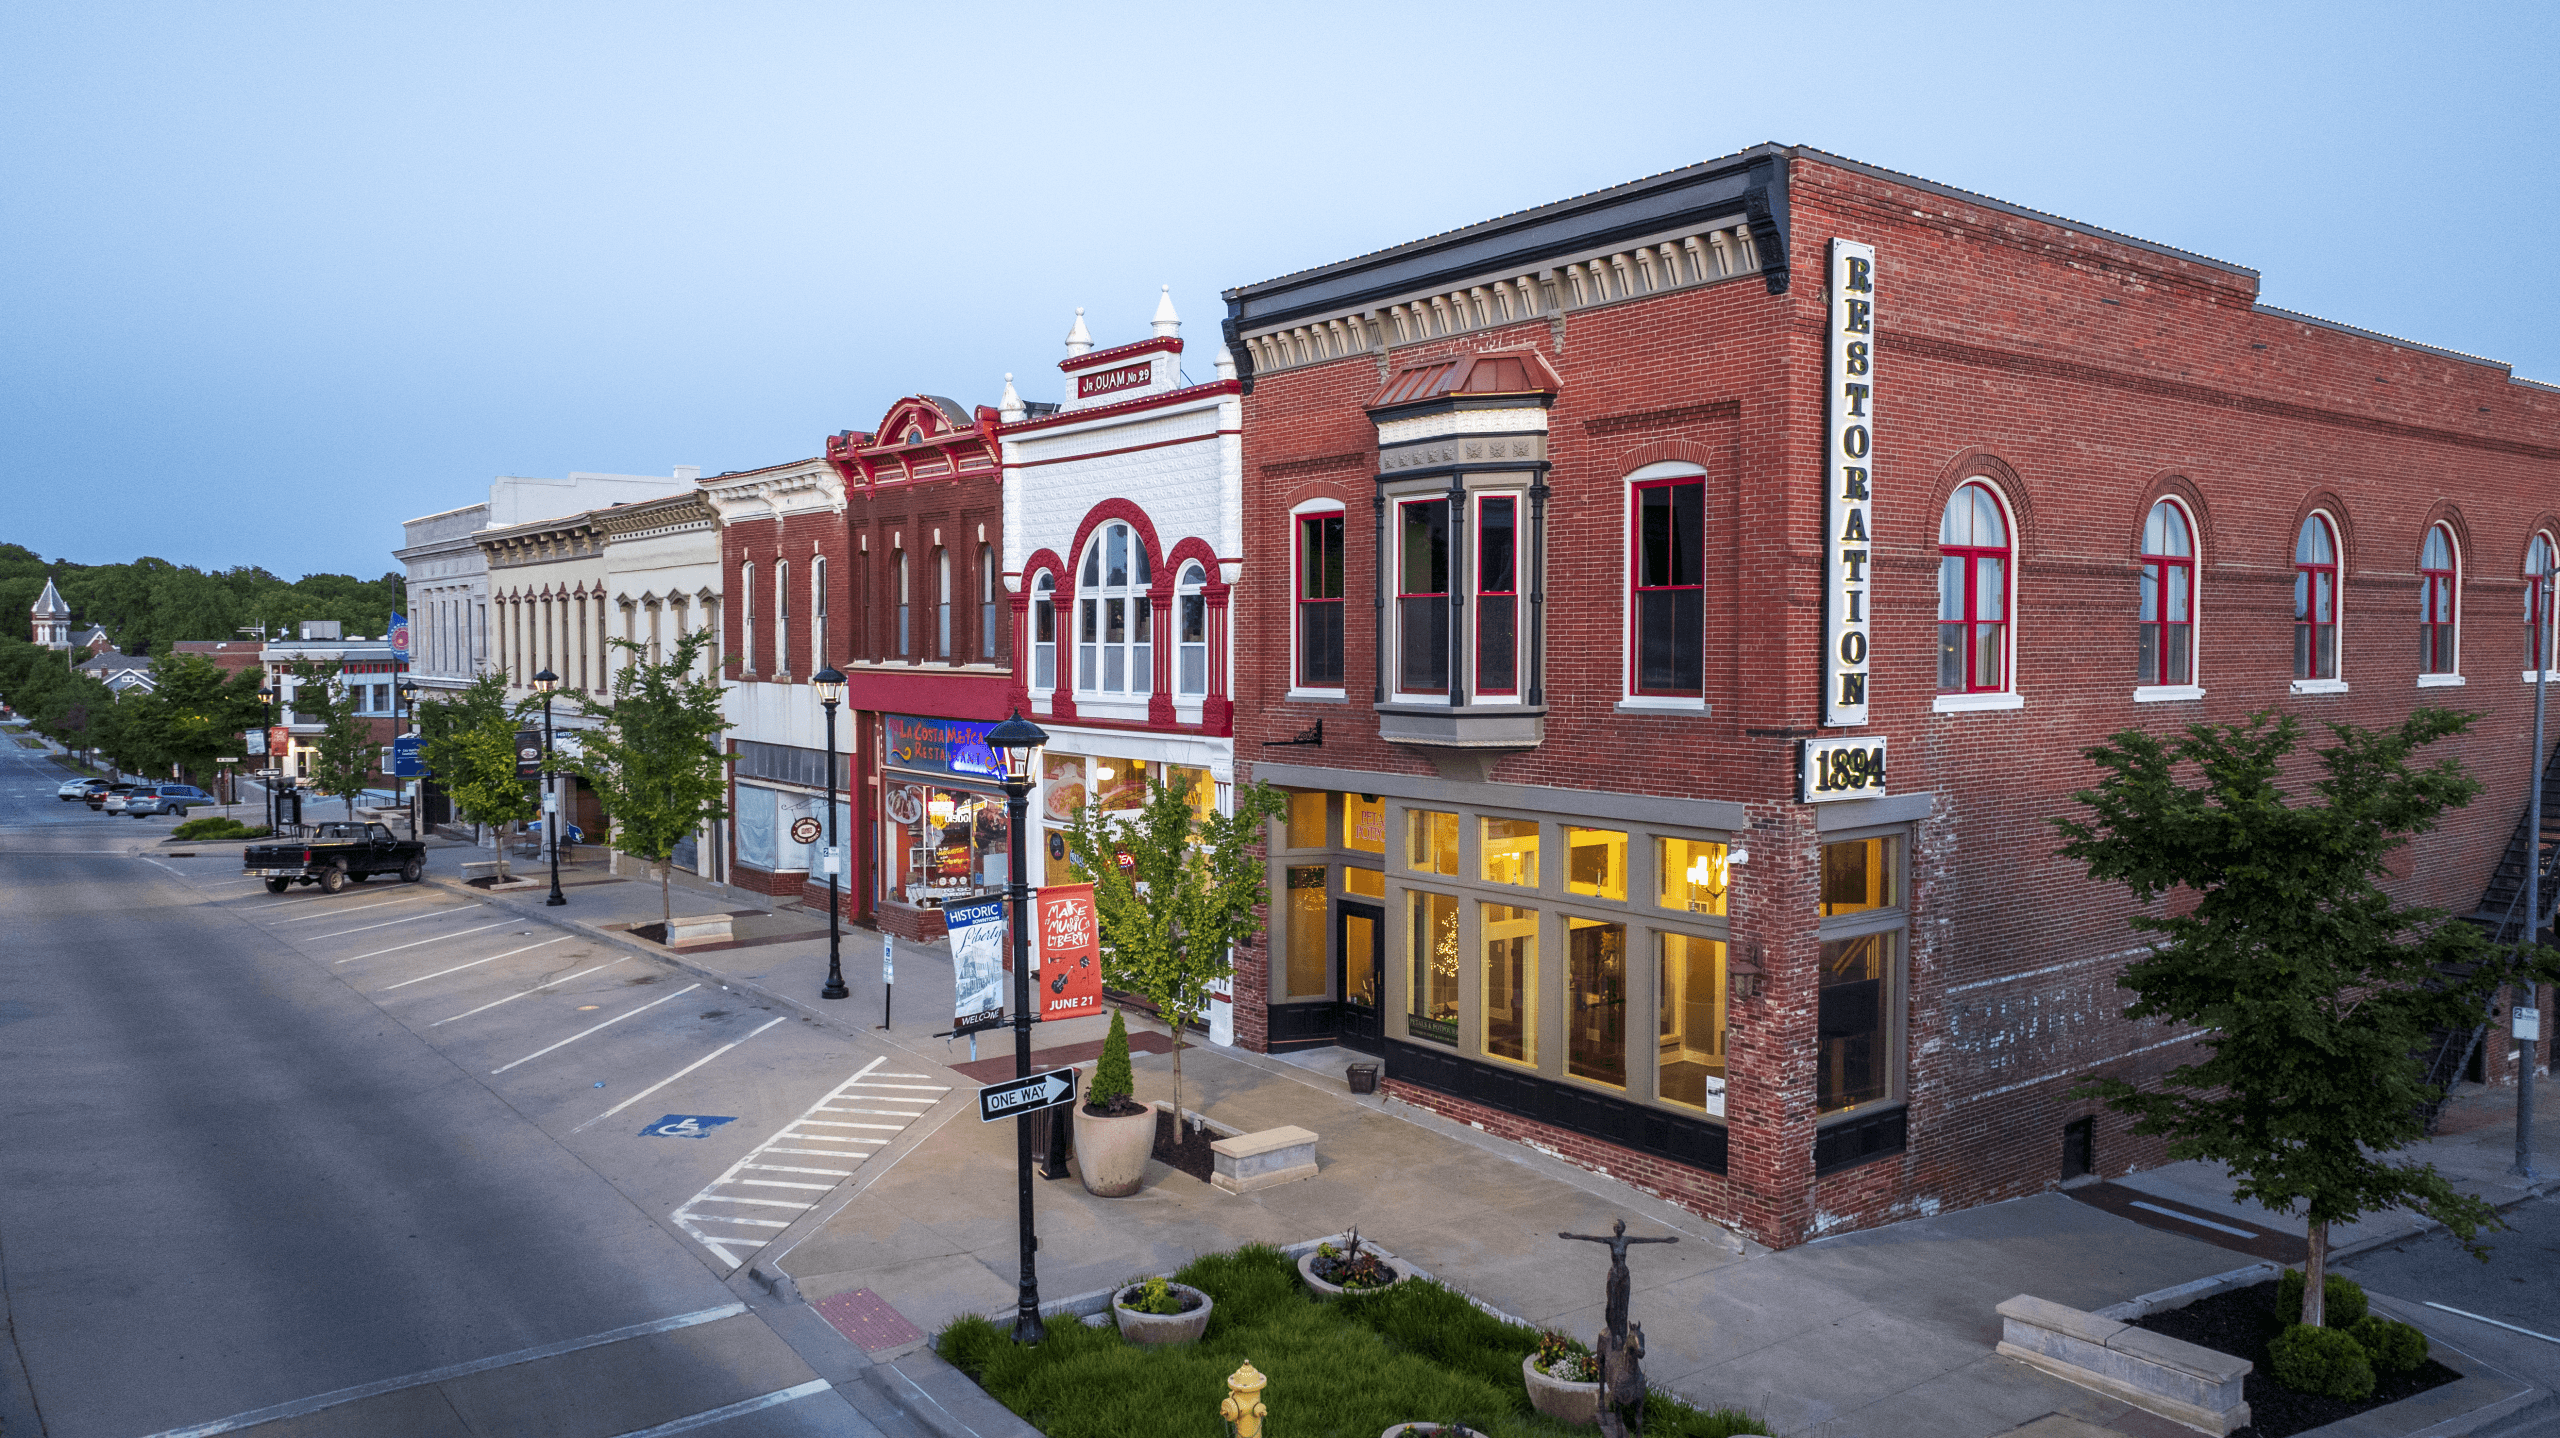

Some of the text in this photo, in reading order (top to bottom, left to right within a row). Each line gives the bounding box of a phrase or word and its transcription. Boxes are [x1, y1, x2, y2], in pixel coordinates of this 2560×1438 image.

[1838, 256, 1872, 707] RESTORATION
[914, 721, 944, 743] COSTA
[1815, 747, 1887, 792] 1894
[1361, 811, 1385, 827] PETA
[949, 904, 999, 924] HISTORIC
[1047, 900, 1088, 919] MAKE
[972, 915, 1000, 925] DOWNTOWN
[1047, 916, 1088, 934] MUSIC
[956, 926, 1003, 958] Liberty
[1047, 931, 1090, 948] LIBERTY
[1049, 996, 1093, 1011] JUNE 21
[961, 1009, 1000, 1026] WELCOME
[991, 1084, 1046, 1109] ONE WAY
